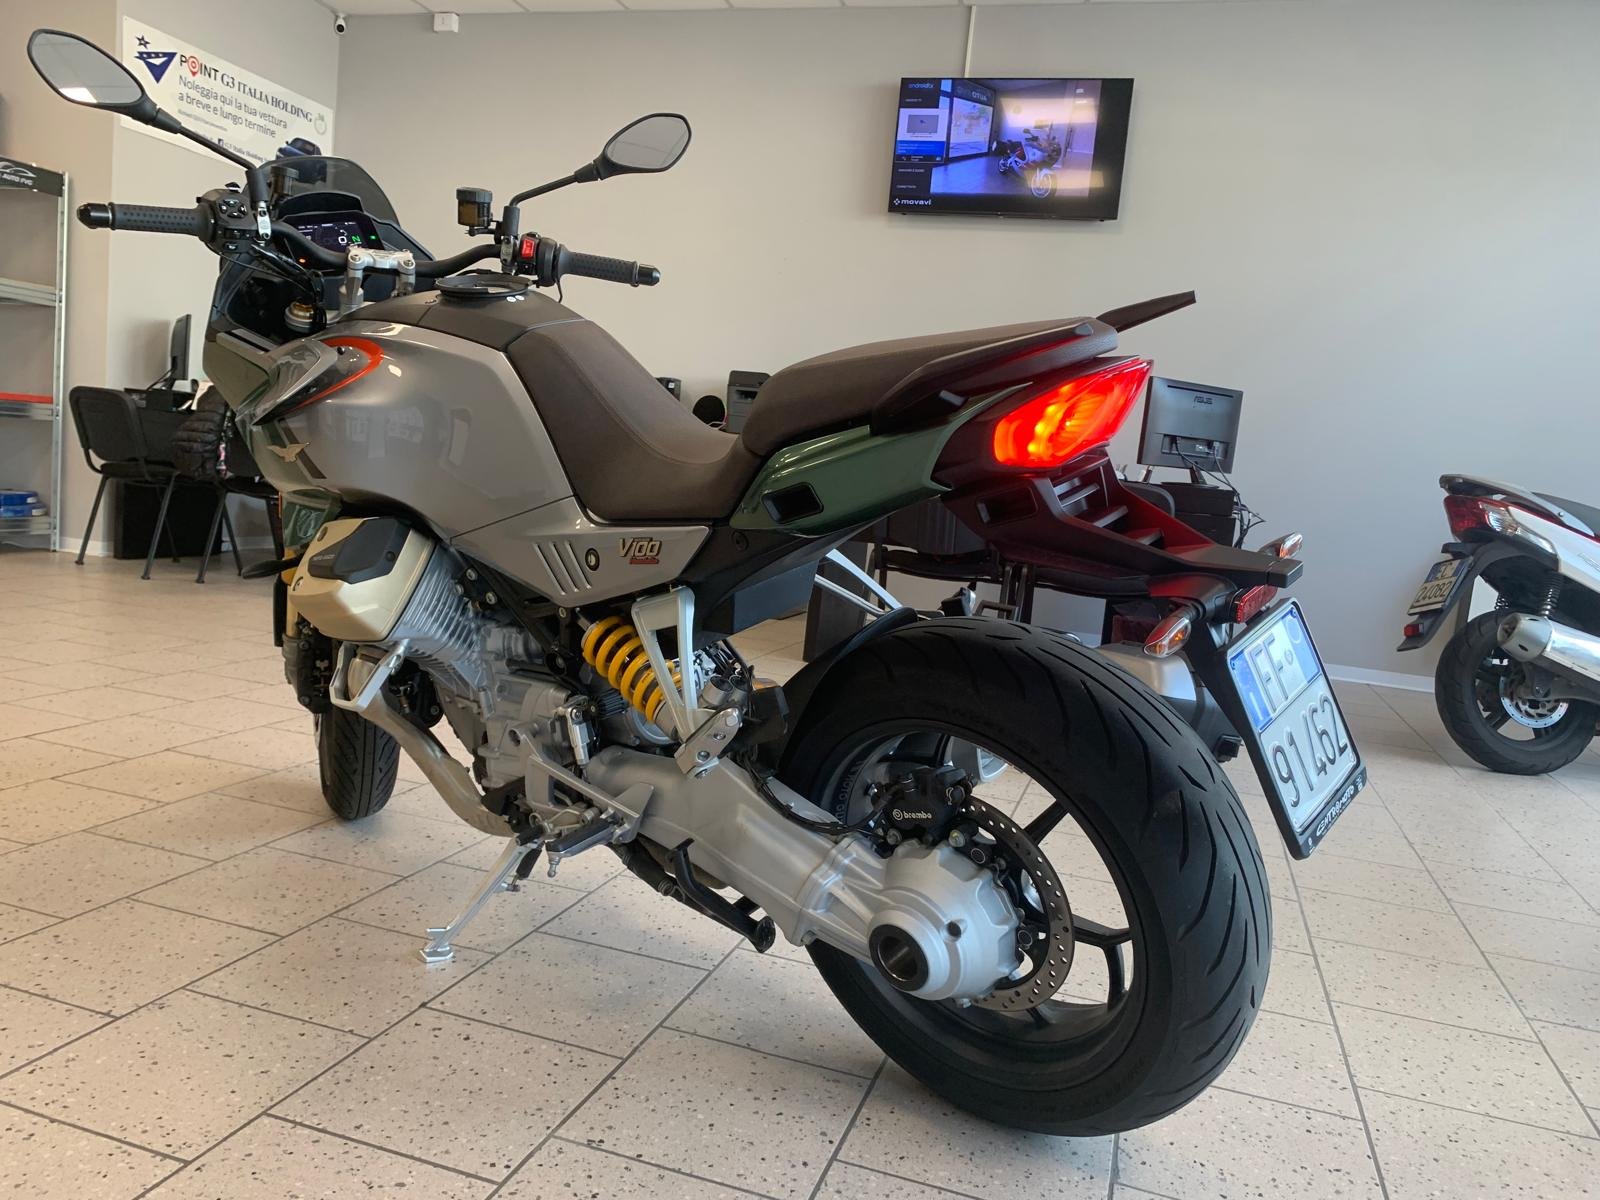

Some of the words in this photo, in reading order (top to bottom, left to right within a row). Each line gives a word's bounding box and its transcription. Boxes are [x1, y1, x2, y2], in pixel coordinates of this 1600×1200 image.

[179, 75, 218, 100] Noleggia
[220, 92, 234, 107] qui
[235, 98, 242, 110] la
[244, 103, 257, 117] tua
[258, 110, 288, 129] vettura
[180, 54, 219, 81] POINT
[221, 73, 235, 89] G3
[238, 81, 269, 105] ITALIA
[271, 96, 313, 122] HOLDING
[178, 92, 185, 101] a
[186, 92, 211, 112] breve
[212, 105, 219, 115] e
[220, 106, 242, 126] lungo
[244, 118, 276, 138] termine
[901, 198, 932, 206] movavi
[619, 538, 662, 557] V100
[1269, 694, 1349, 808] 91462
[903, 810, 932, 819] brembo
